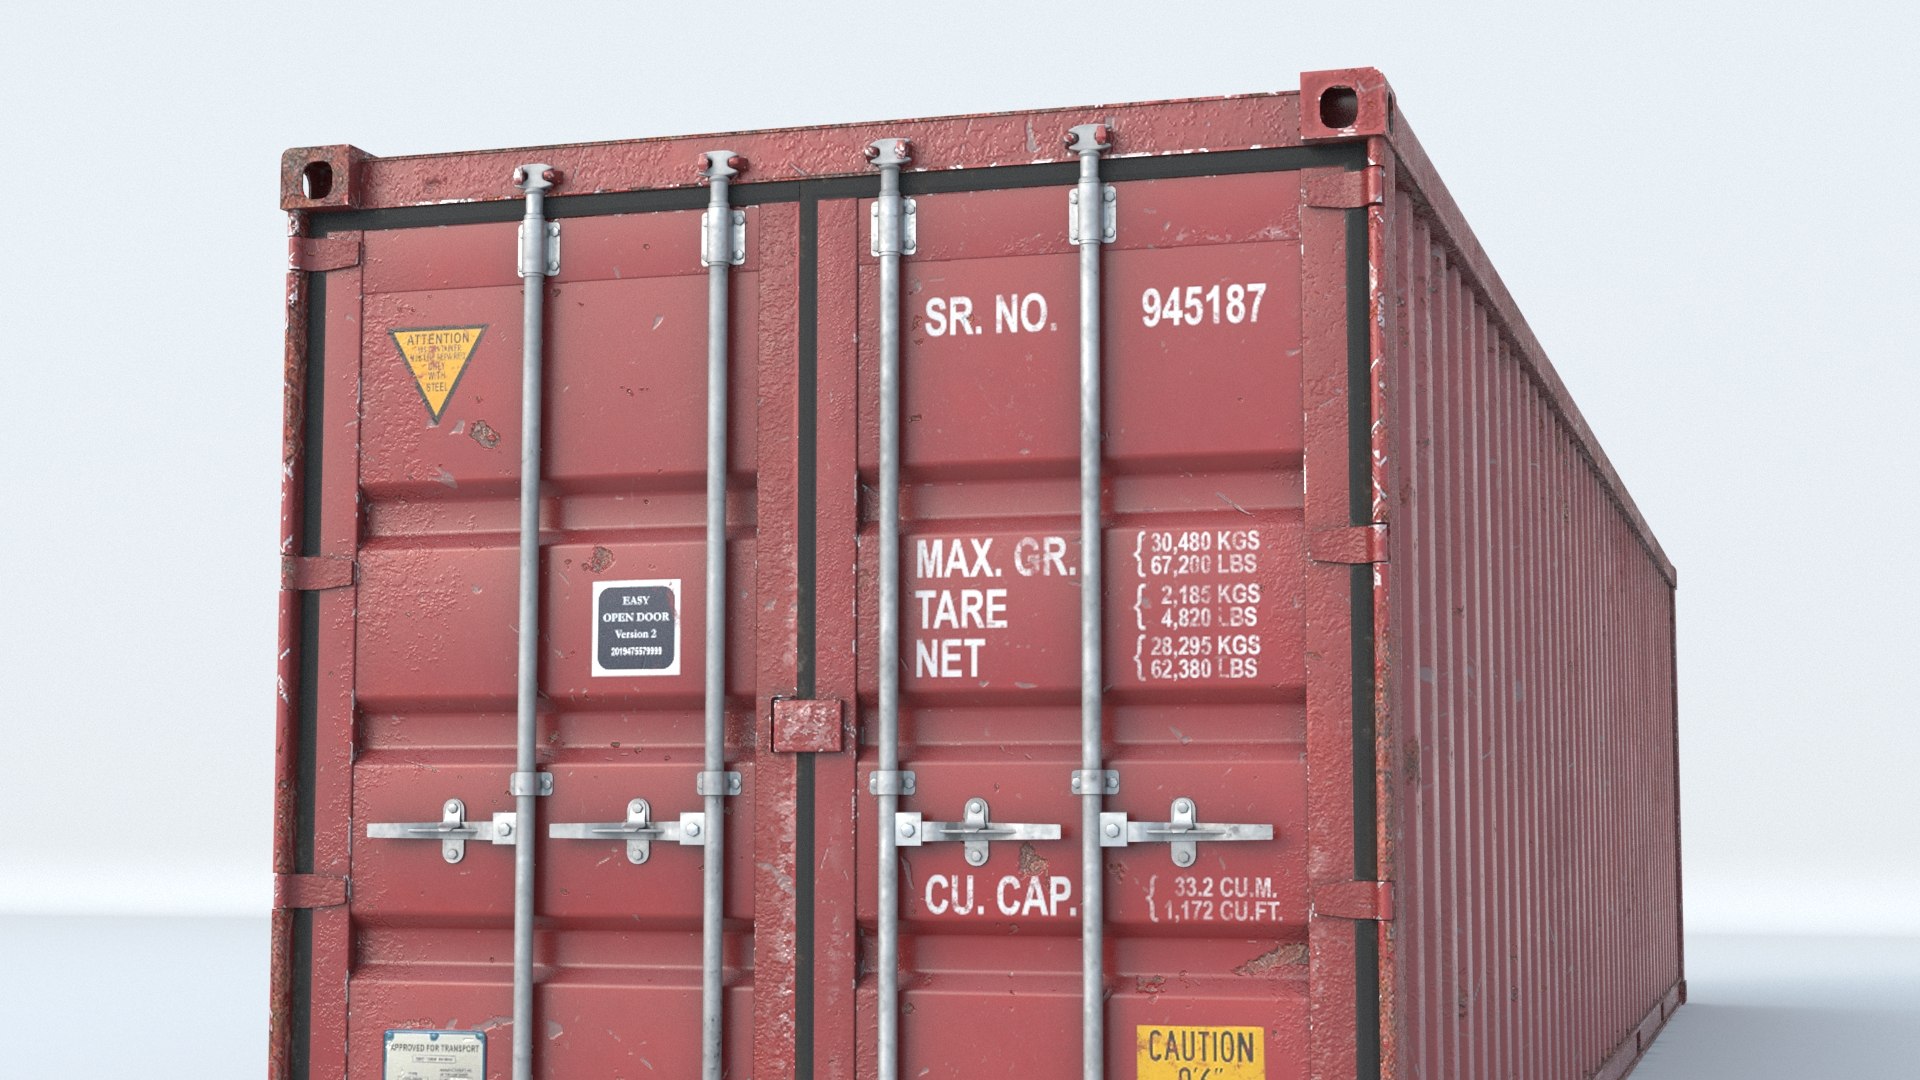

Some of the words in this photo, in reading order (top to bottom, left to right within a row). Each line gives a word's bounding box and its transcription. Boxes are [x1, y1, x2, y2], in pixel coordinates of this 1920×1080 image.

[925, 296, 982, 337] SR.
[995, 293, 1057, 334] NO.
[1142, 283, 1266, 327] 945187
[407, 332, 470, 345] ATTENTION
[426, 382, 448, 392] STEEL
[1151, 531, 1211, 555] 30,480
[1218, 530, 1260, 551] KGS
[916, 538, 1002, 579] MAX.
[1013, 536, 1077, 577] GR.
[1218, 553, 1257, 574] LBS
[622, 595, 651, 606] EASY
[1161, 585, 1211, 608] 2,185
[1218, 583, 1260, 604] KGS
[602, 612, 635, 623] OPEN
[636, 612, 670, 622] DOOR
[915, 588, 1008, 630] TARE
[1161, 607, 1211, 630] 4,820
[1218, 606, 1257, 627] LBS
[614, 629, 649, 639] Version
[650, 629, 658, 639] 2
[915, 638, 986, 679] NET
[1151, 635, 1212, 659] 28,295
[1218, 634, 1261, 655] KGS
[1151, 658, 1212, 682] 62,380
[1218, 658, 1258, 679] LBS
[925, 874, 985, 916] CU.
[996, 875, 1078, 917] CAP.
[1174, 876, 1214, 898] 33.2
[1164, 900, 1214, 923] 1,172
[390, 1043, 425, 1052] APPROVED
[426, 1043, 440, 1052] FOR
[441, 1043, 480, 1052] TRANSPORT
[1149, 1030, 1254, 1062] CAUTION
